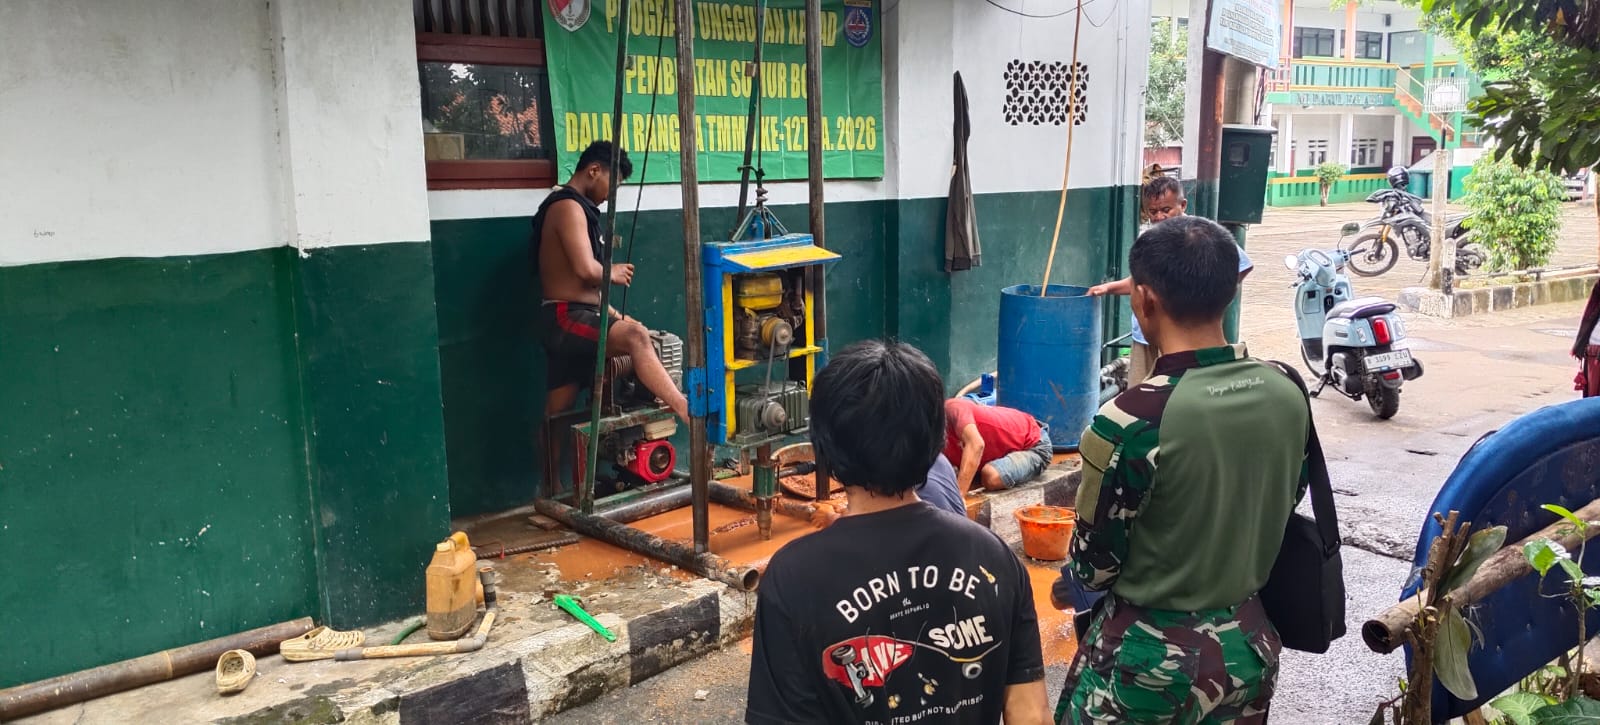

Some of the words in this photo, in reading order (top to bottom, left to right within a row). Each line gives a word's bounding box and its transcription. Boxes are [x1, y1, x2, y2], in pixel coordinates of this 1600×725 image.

[697, 2, 785, 44] UNGGUAN
[788, 9, 838, 47] KAAD
[632, 113, 705, 152] RANGA
[836, 115, 876, 151] 2026
[836, 570, 901, 623] BORN
[908, 565, 939, 589] TO
[949, 567, 980, 600] BE
[928, 615, 994, 650] SOME
[912, 711, 926, 722] BUT
[927, 706, 944, 716] NOT
